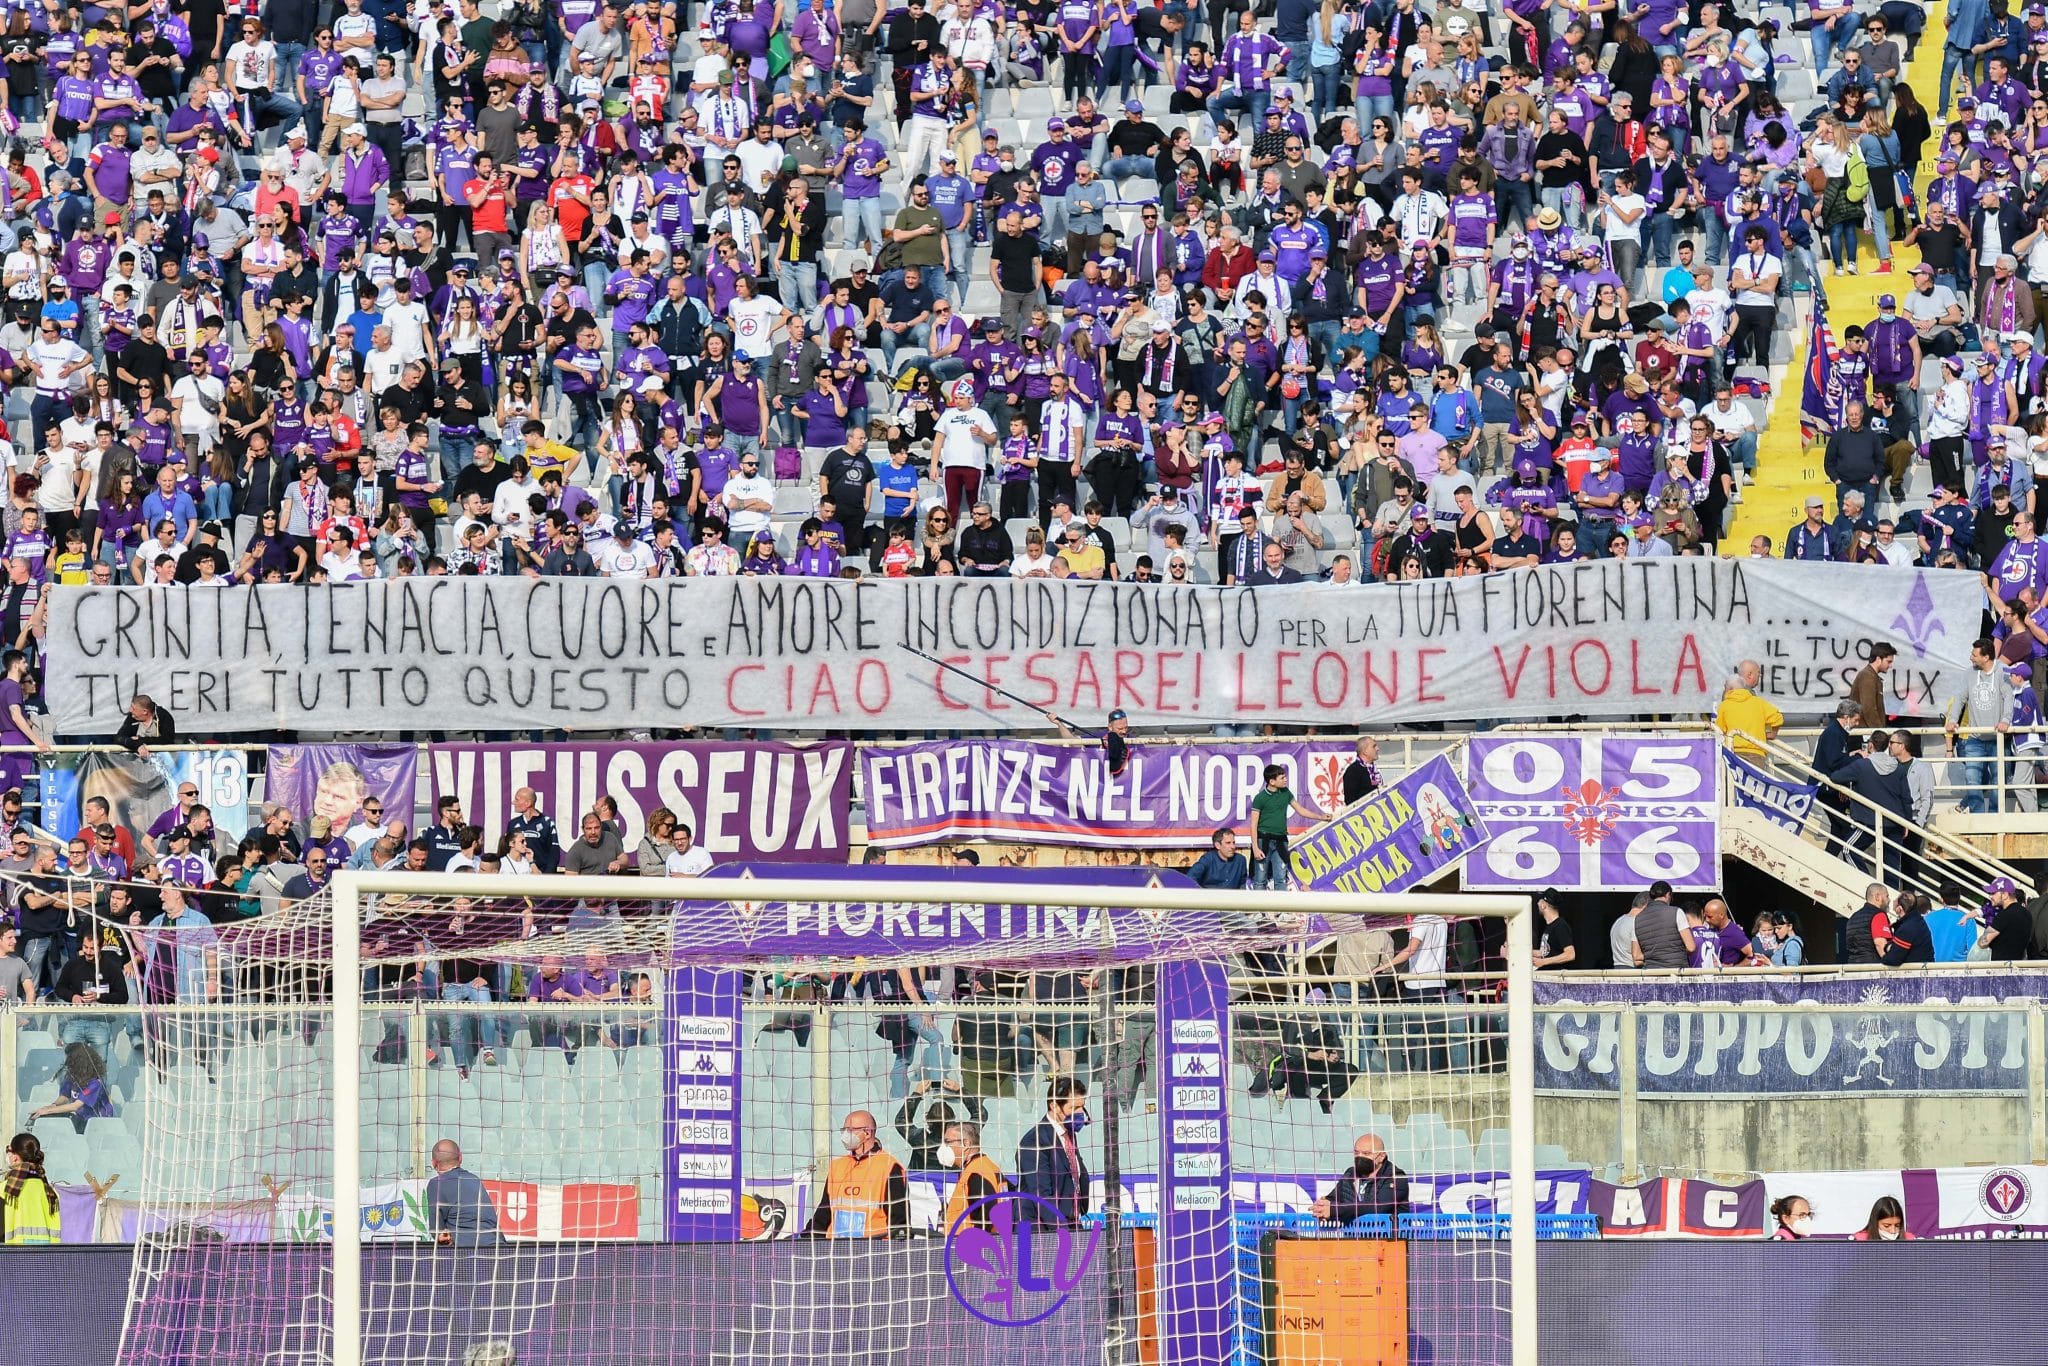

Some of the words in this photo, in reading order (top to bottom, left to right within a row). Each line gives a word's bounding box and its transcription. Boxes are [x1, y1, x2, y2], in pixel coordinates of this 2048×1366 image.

[1921, 161, 1934, 173] 19
[1802, 467, 1815, 481] 10
[1791, 506, 1798, 518] 9
[1778, 541, 1785, 553] 8
[526, 582, 686, 660] CUORE
[726, 581, 879, 657] AMORE
[904, 582, 1258, 650] INCONDIZIONATO
[1279, 617, 1328, 649] PER
[1346, 614, 1378, 644] LA
[1391, 580, 1461, 639] TUA
[1766, 638, 1790, 658] IL
[1806, 636, 1874, 661] TUO
[75, 672, 140, 717] TU
[171, 670, 230, 713] ERI
[262, 666, 428, 710] TUTTO
[464, 665, 691, 711] QUESTO
[726, 658, 892, 716] CIAO
[936, 650, 1203, 711] CESARE!
[1234, 648, 1448, 709] LEONE
[1493, 633, 1708, 702] VIOLA
[1734, 664, 1941, 706] IEUSSUX
[195, 757, 242, 809] 13
[869, 745, 1057, 824] FIRENZE
[1066, 752, 1156, 822] NEL
[433, 747, 845, 854] VIEUSSEUX
[1476, 803, 1708, 820] FOLLONICA
[1290, 789, 1415, 887] CALABRIA
[1332, 844, 1413, 893] VIOLA
[786, 901, 1118, 943] FIORENTINA
[681, 1023, 726, 1036] Mediacom
[1174, 1027, 1213, 1038] Mediacom
[680, 1196, 726, 1209] Mediacom
[844, 1185, 861, 1196] CO
[1611, 1187, 1647, 1226] A
[1702, 1189, 1739, 1228] C
